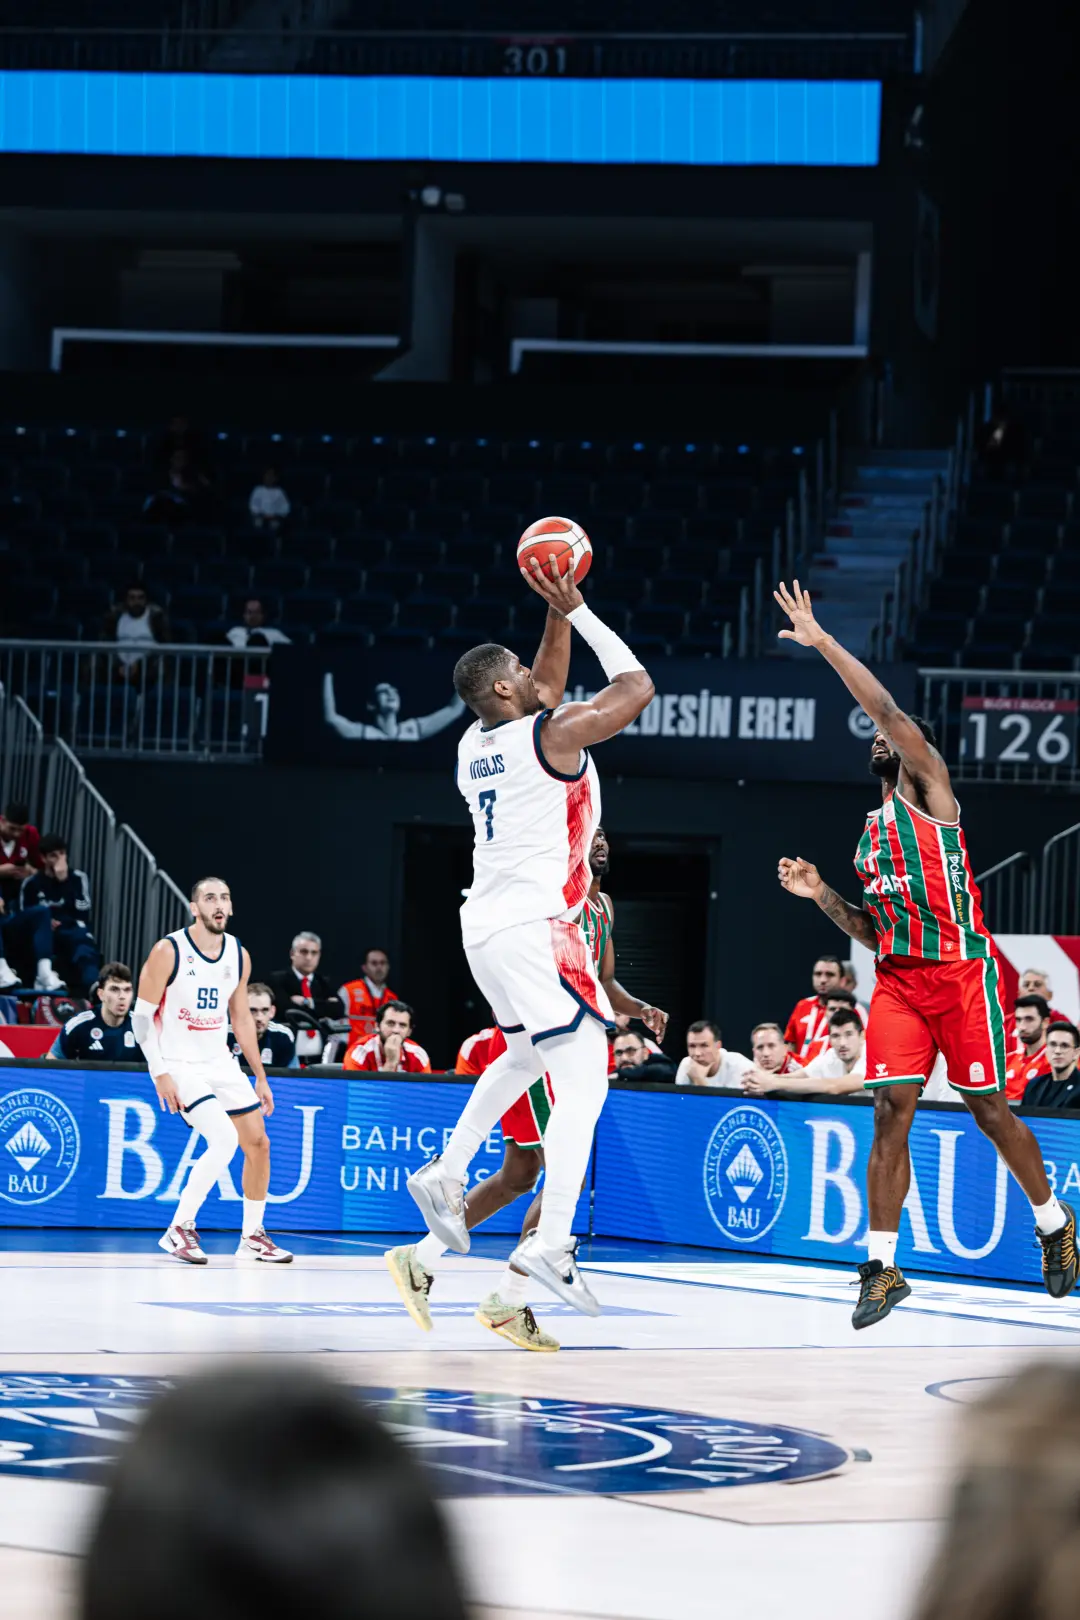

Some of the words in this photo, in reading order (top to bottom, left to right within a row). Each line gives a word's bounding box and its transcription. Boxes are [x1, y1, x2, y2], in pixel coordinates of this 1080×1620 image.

[504, 46, 567, 74] 301
[737, 697, 816, 741] EREN
[968, 713, 1071, 764] 126
[469, 753, 505, 780] INGLIS
[478, 789, 497, 842] 7
[196, 987, 219, 1010] 55
[8, 1173, 48, 1194] BAU
[727, 1205, 761, 1230] BAU
